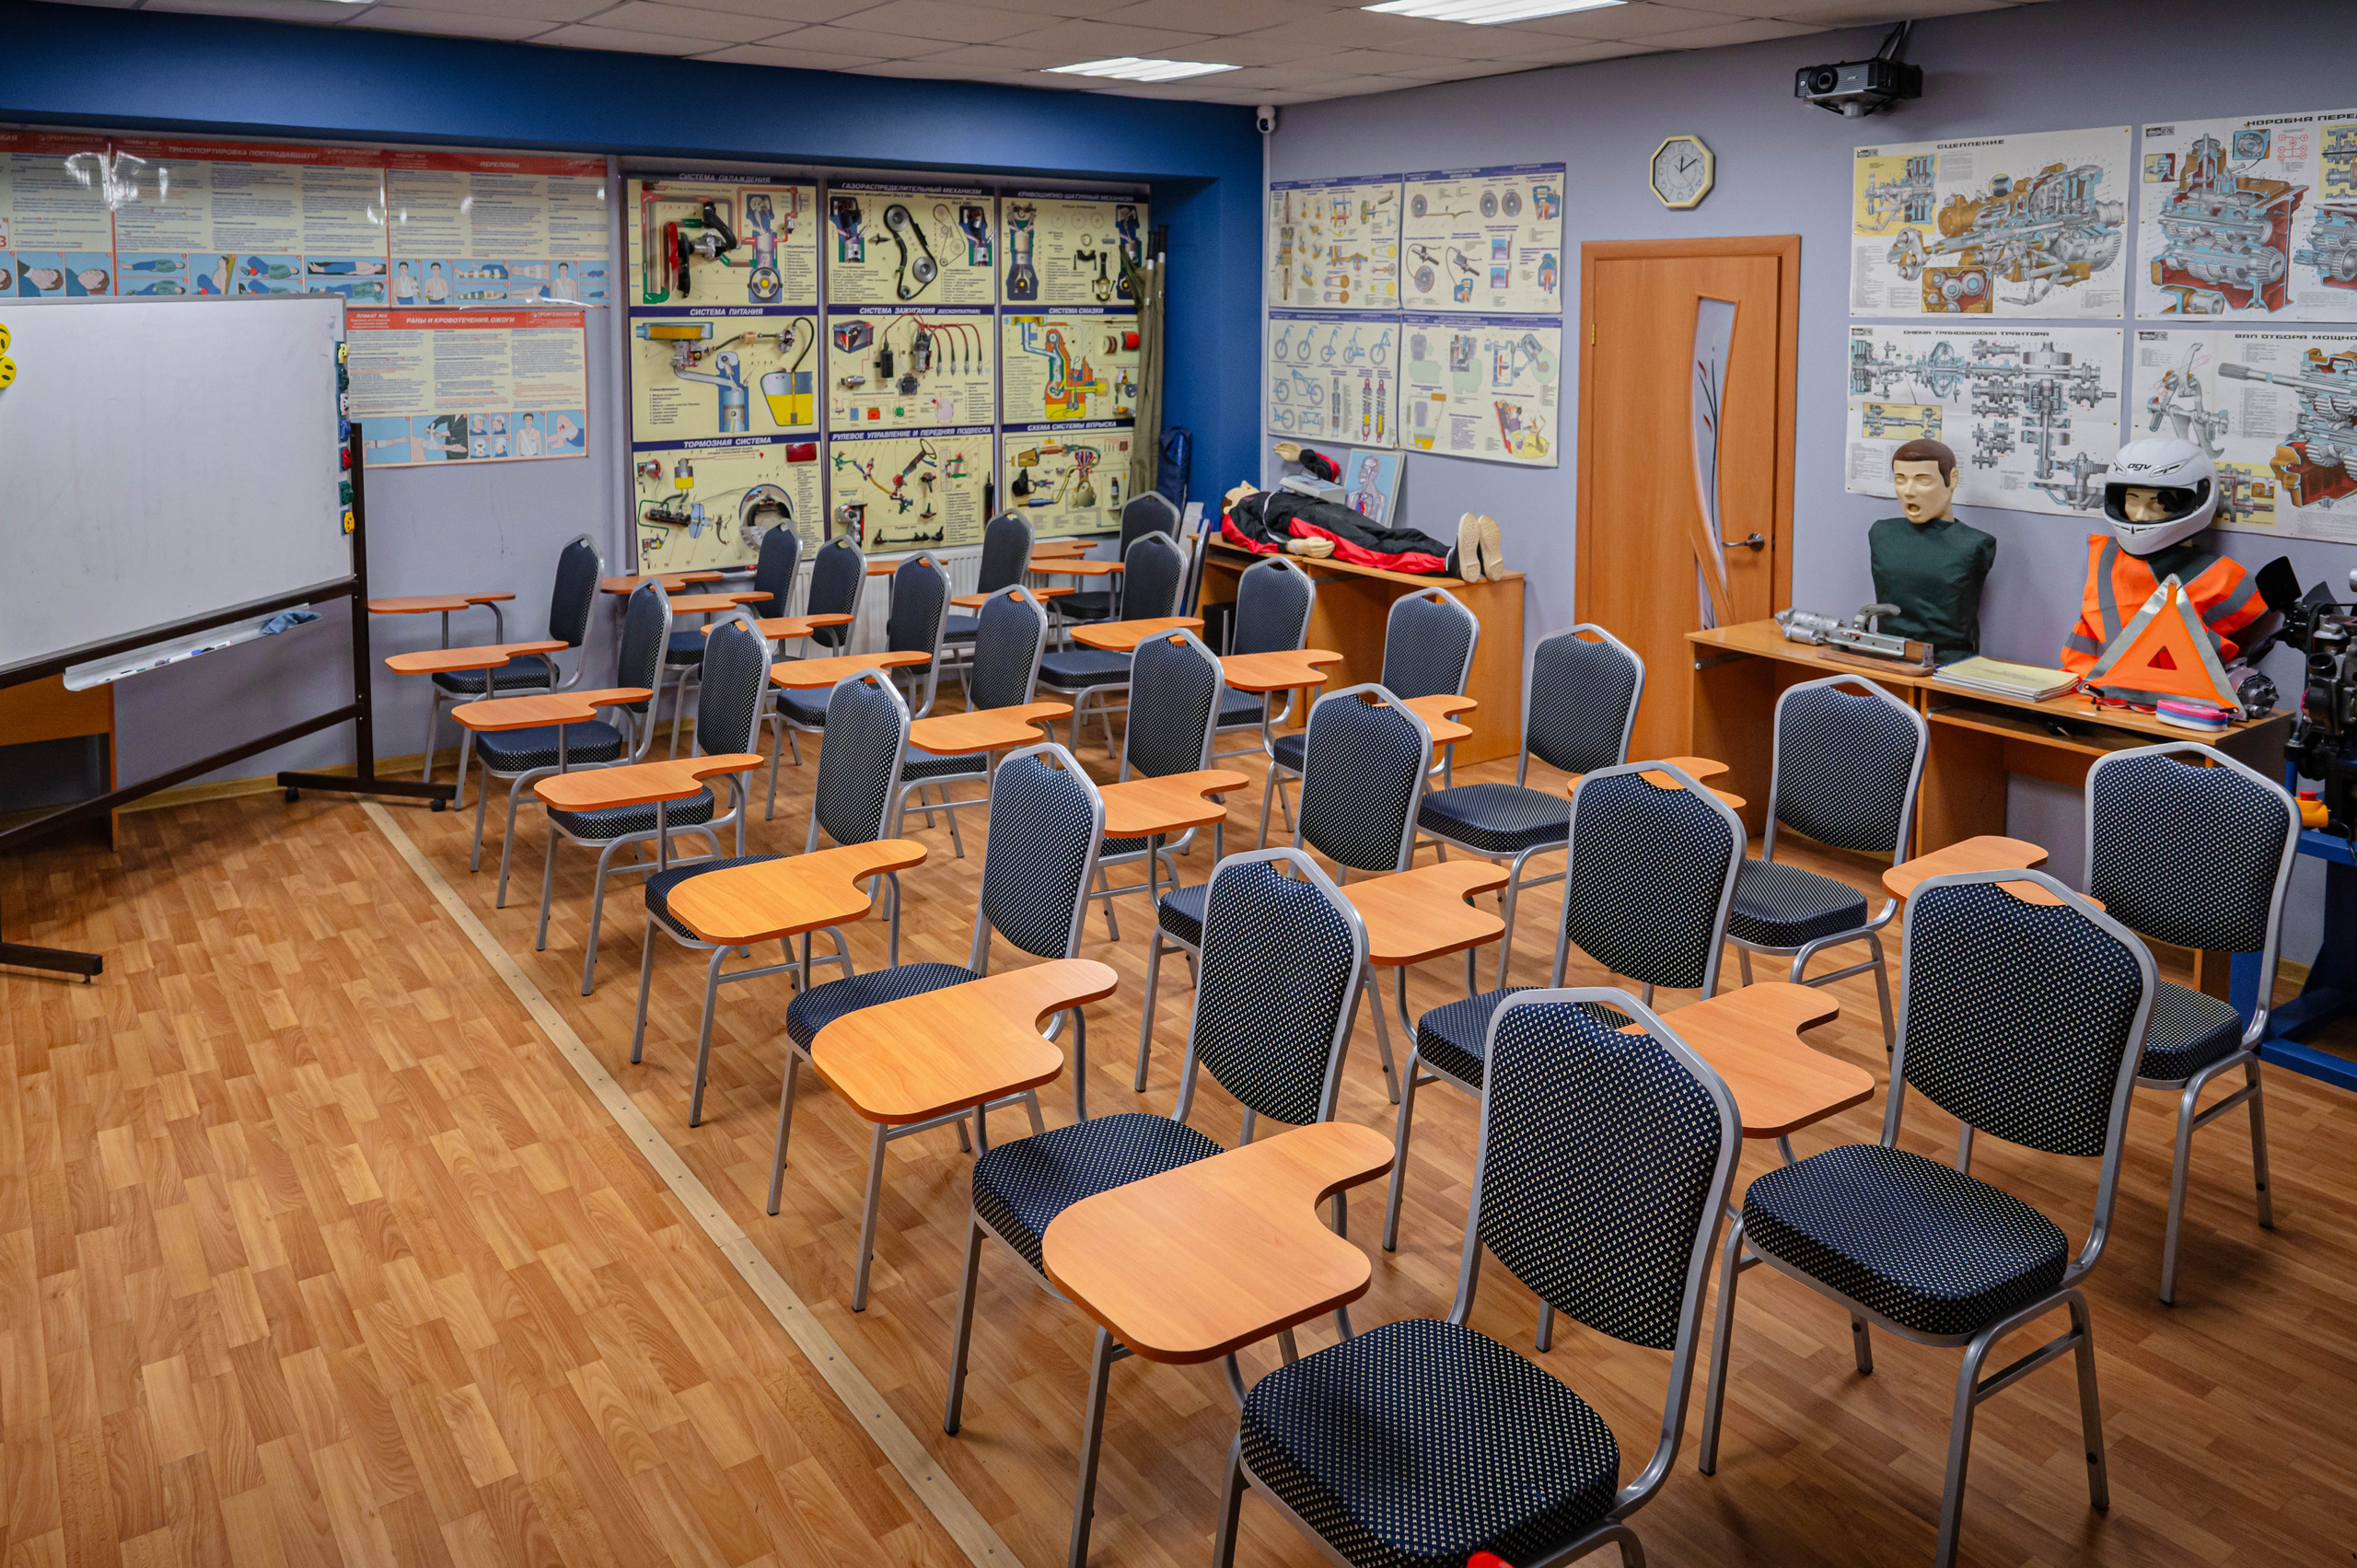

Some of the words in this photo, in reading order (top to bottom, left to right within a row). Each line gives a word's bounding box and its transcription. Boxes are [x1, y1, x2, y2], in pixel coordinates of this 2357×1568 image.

[2247, 116, 2314, 127] КОРОБКА
[2317, 112, 2357, 122] ПЕРЕ
[1678, 142, 1686, 153] 12
[1936, 139, 2005, 149] СЦЕПЛЕНИЕ
[168, 146, 248, 157] ТРАНСПОРТИРОВКА
[249, 149, 319, 159] ПОСТРАДАВШЕГО
[1668, 145, 1675, 155] 11
[1696, 152, 1703, 163] 2
[1657, 168, 1665, 176] 9
[679, 172, 715, 182] СИСТЕМА
[718, 174, 771, 183] ОХЛАЖДЕНИЯ
[1695, 178, 1701, 187] 4
[842, 182, 942, 193] ГАЗОРАСПРЕДЕЛИТЕЛЬНЫЙ
[942, 187, 982, 195] МЕХАНИЗМ
[1661, 180, 1667, 190] 8
[1017, 191, 1099, 201] КРИВОШИПНО-ШАТУННЫЙ
[1668, 189, 1674, 198] 7
[1677, 191, 1684, 200] 6
[728, 308, 763, 316] ПИТАНИЯ
[1027, 424, 1051, 432] СХЕМА
[1051, 423, 1085, 431] СИСТЕМЫ
[1085, 421, 1117, 429] ВПРЫСКА
[832, 432, 864, 440] РУЛЕВОЕ
[866, 430, 911, 439] УПРАВЛЕНИЕ
[920, 428, 955, 436] ПЕРЕДНЯЯ
[957, 426, 992, 435] ПОДВЕСКА
[683, 438, 733, 448] ТОРМОЗНАЯ
[735, 436, 772, 446] СИСТЕМА
[2127, 463, 2152, 471] agv
